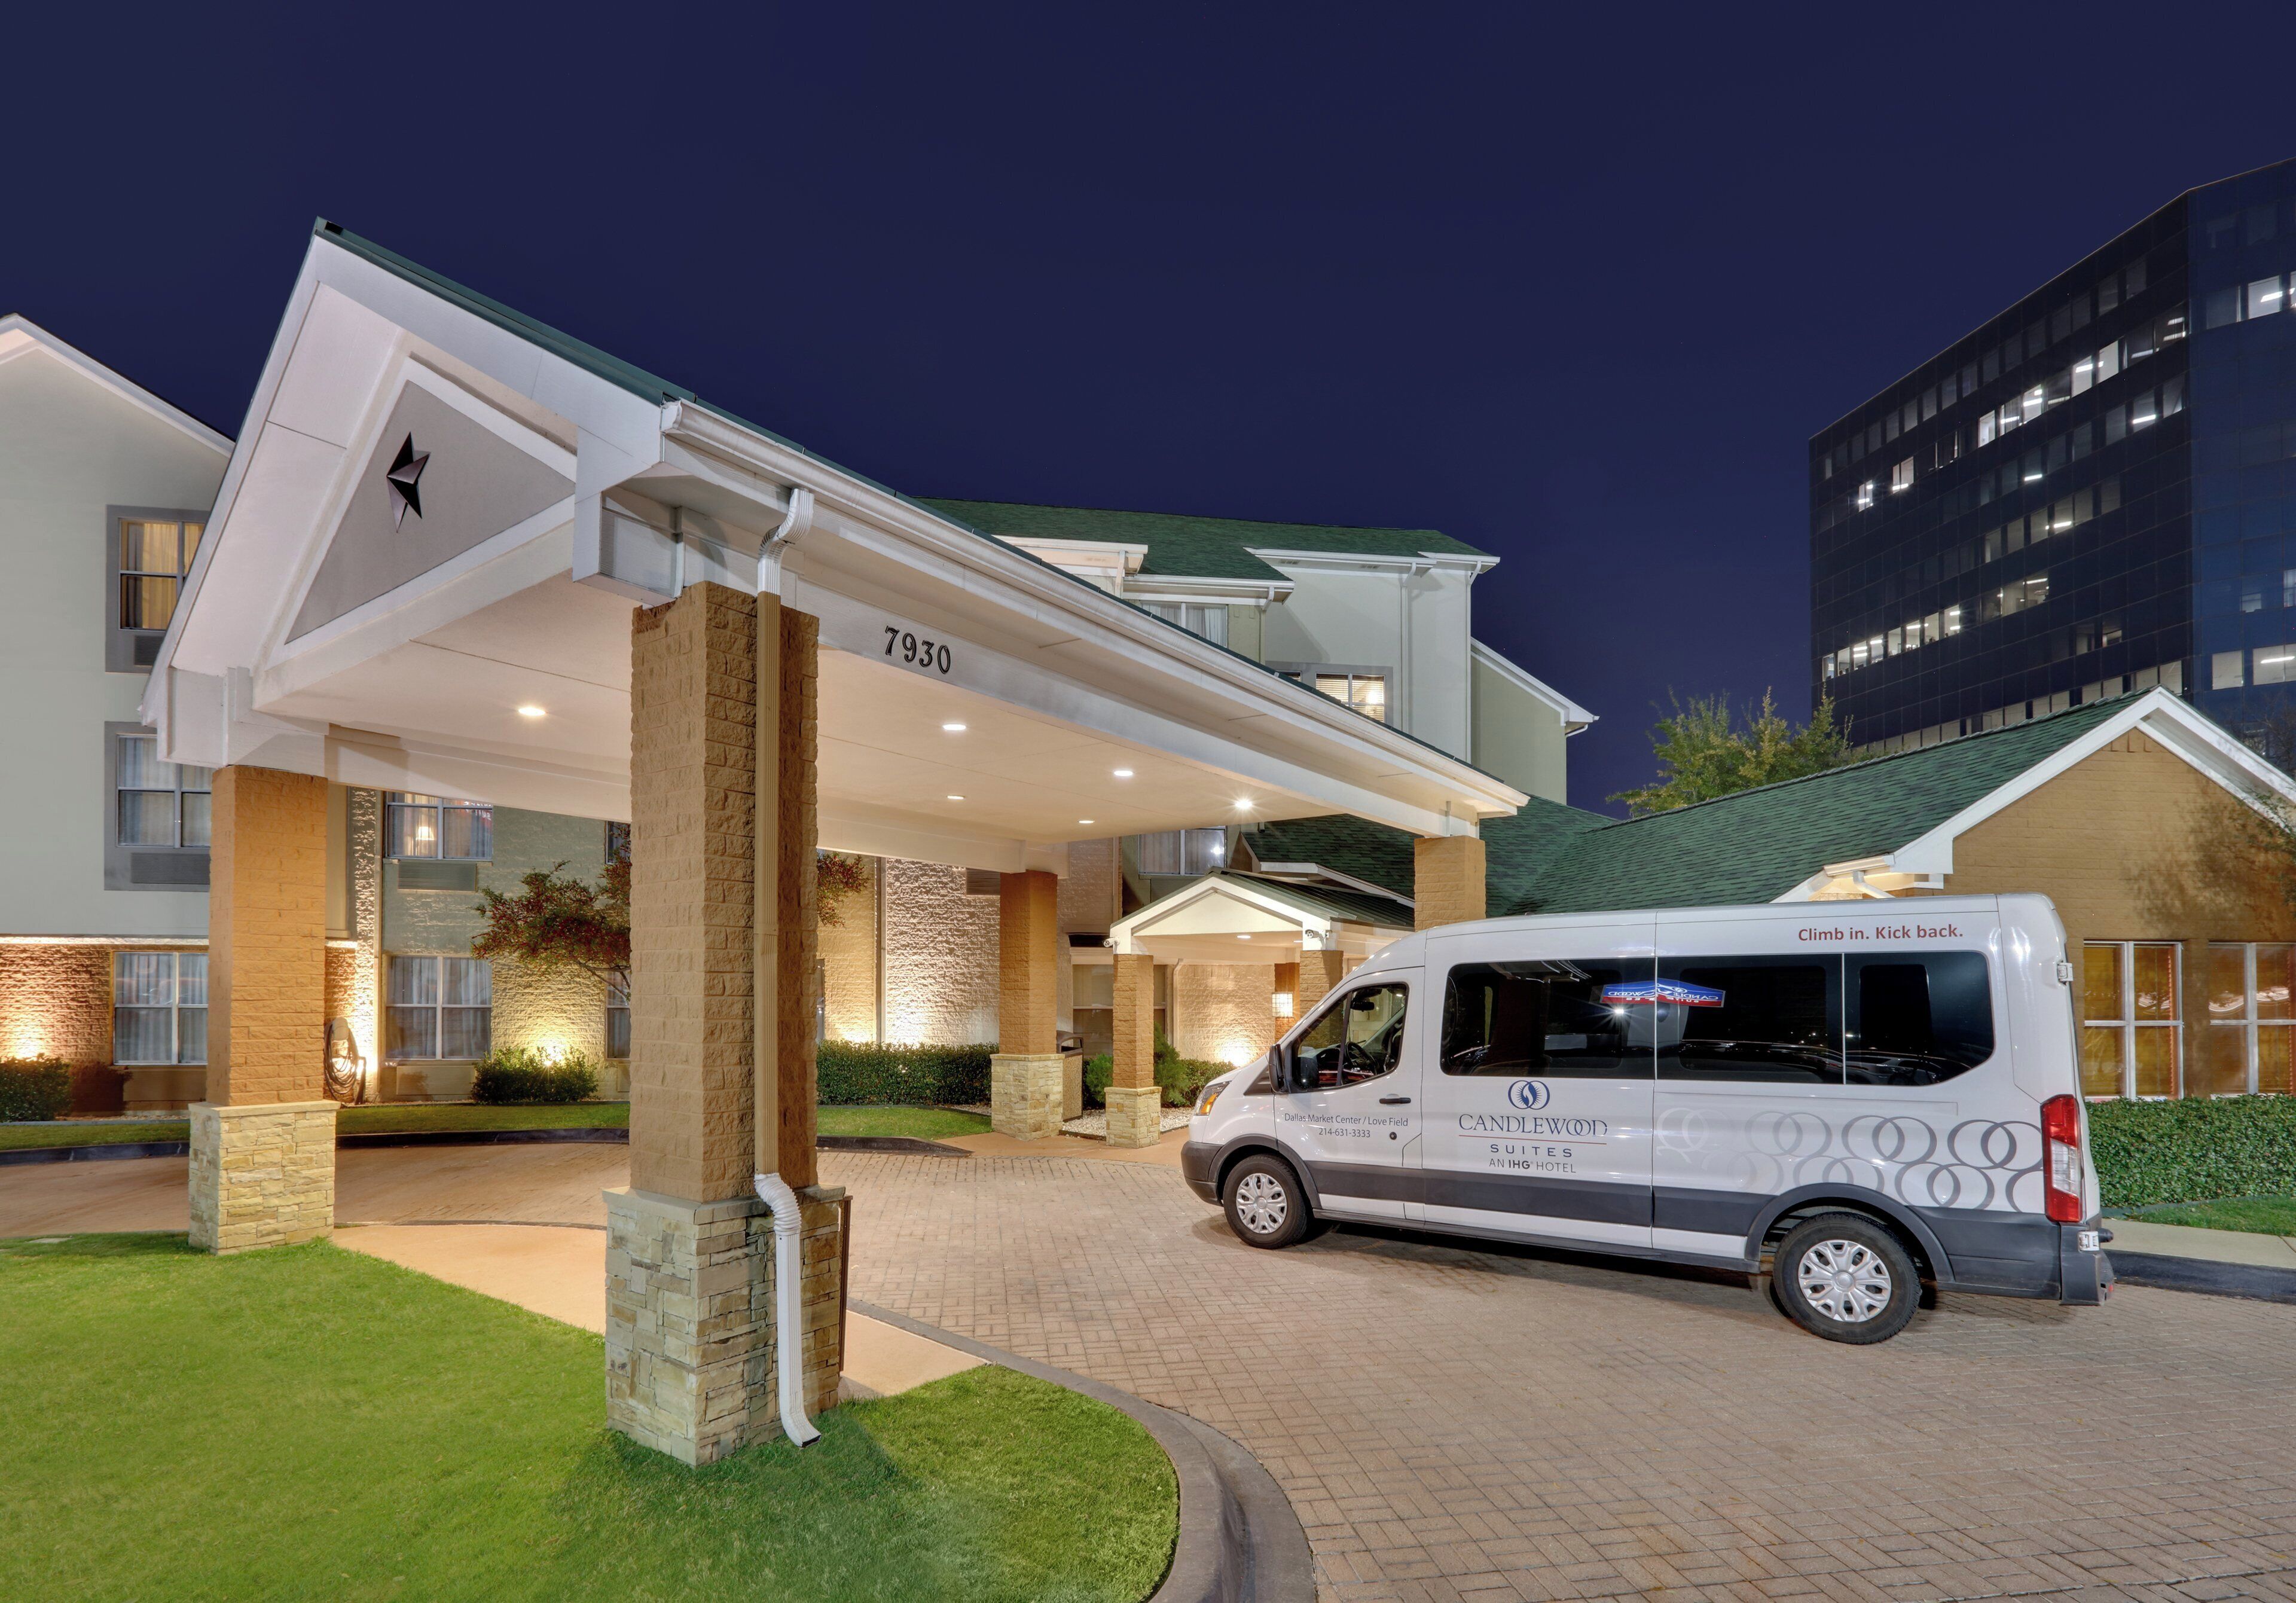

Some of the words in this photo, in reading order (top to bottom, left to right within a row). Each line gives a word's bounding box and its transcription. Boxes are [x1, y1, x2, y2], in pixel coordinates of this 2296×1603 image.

[885, 625, 951, 674] 7930
[1799, 927, 1844, 941] Climb
[1850, 927, 1870, 940] in.
[1876, 926, 1912, 939] Kick
[1917, 924, 1964, 938] back.
[1284, 1113, 1306, 1122] Dallas
[1308, 1115, 1333, 1123] Market
[1336, 1115, 1361, 1124] Center
[1362, 1116, 1367, 1125] /
[1368, 1116, 1387, 1125] Love
[1389, 1117, 1408, 1126] Field
[1459, 1114, 1608, 1136] CANDLEWOOD
[1318, 1128, 1370, 1138] 214-631-3333
[1491, 1144, 1572, 1157] SUITES
[1489, 1158, 1504, 1168] AN
[1536, 1161, 1576, 1173] HOTEL
